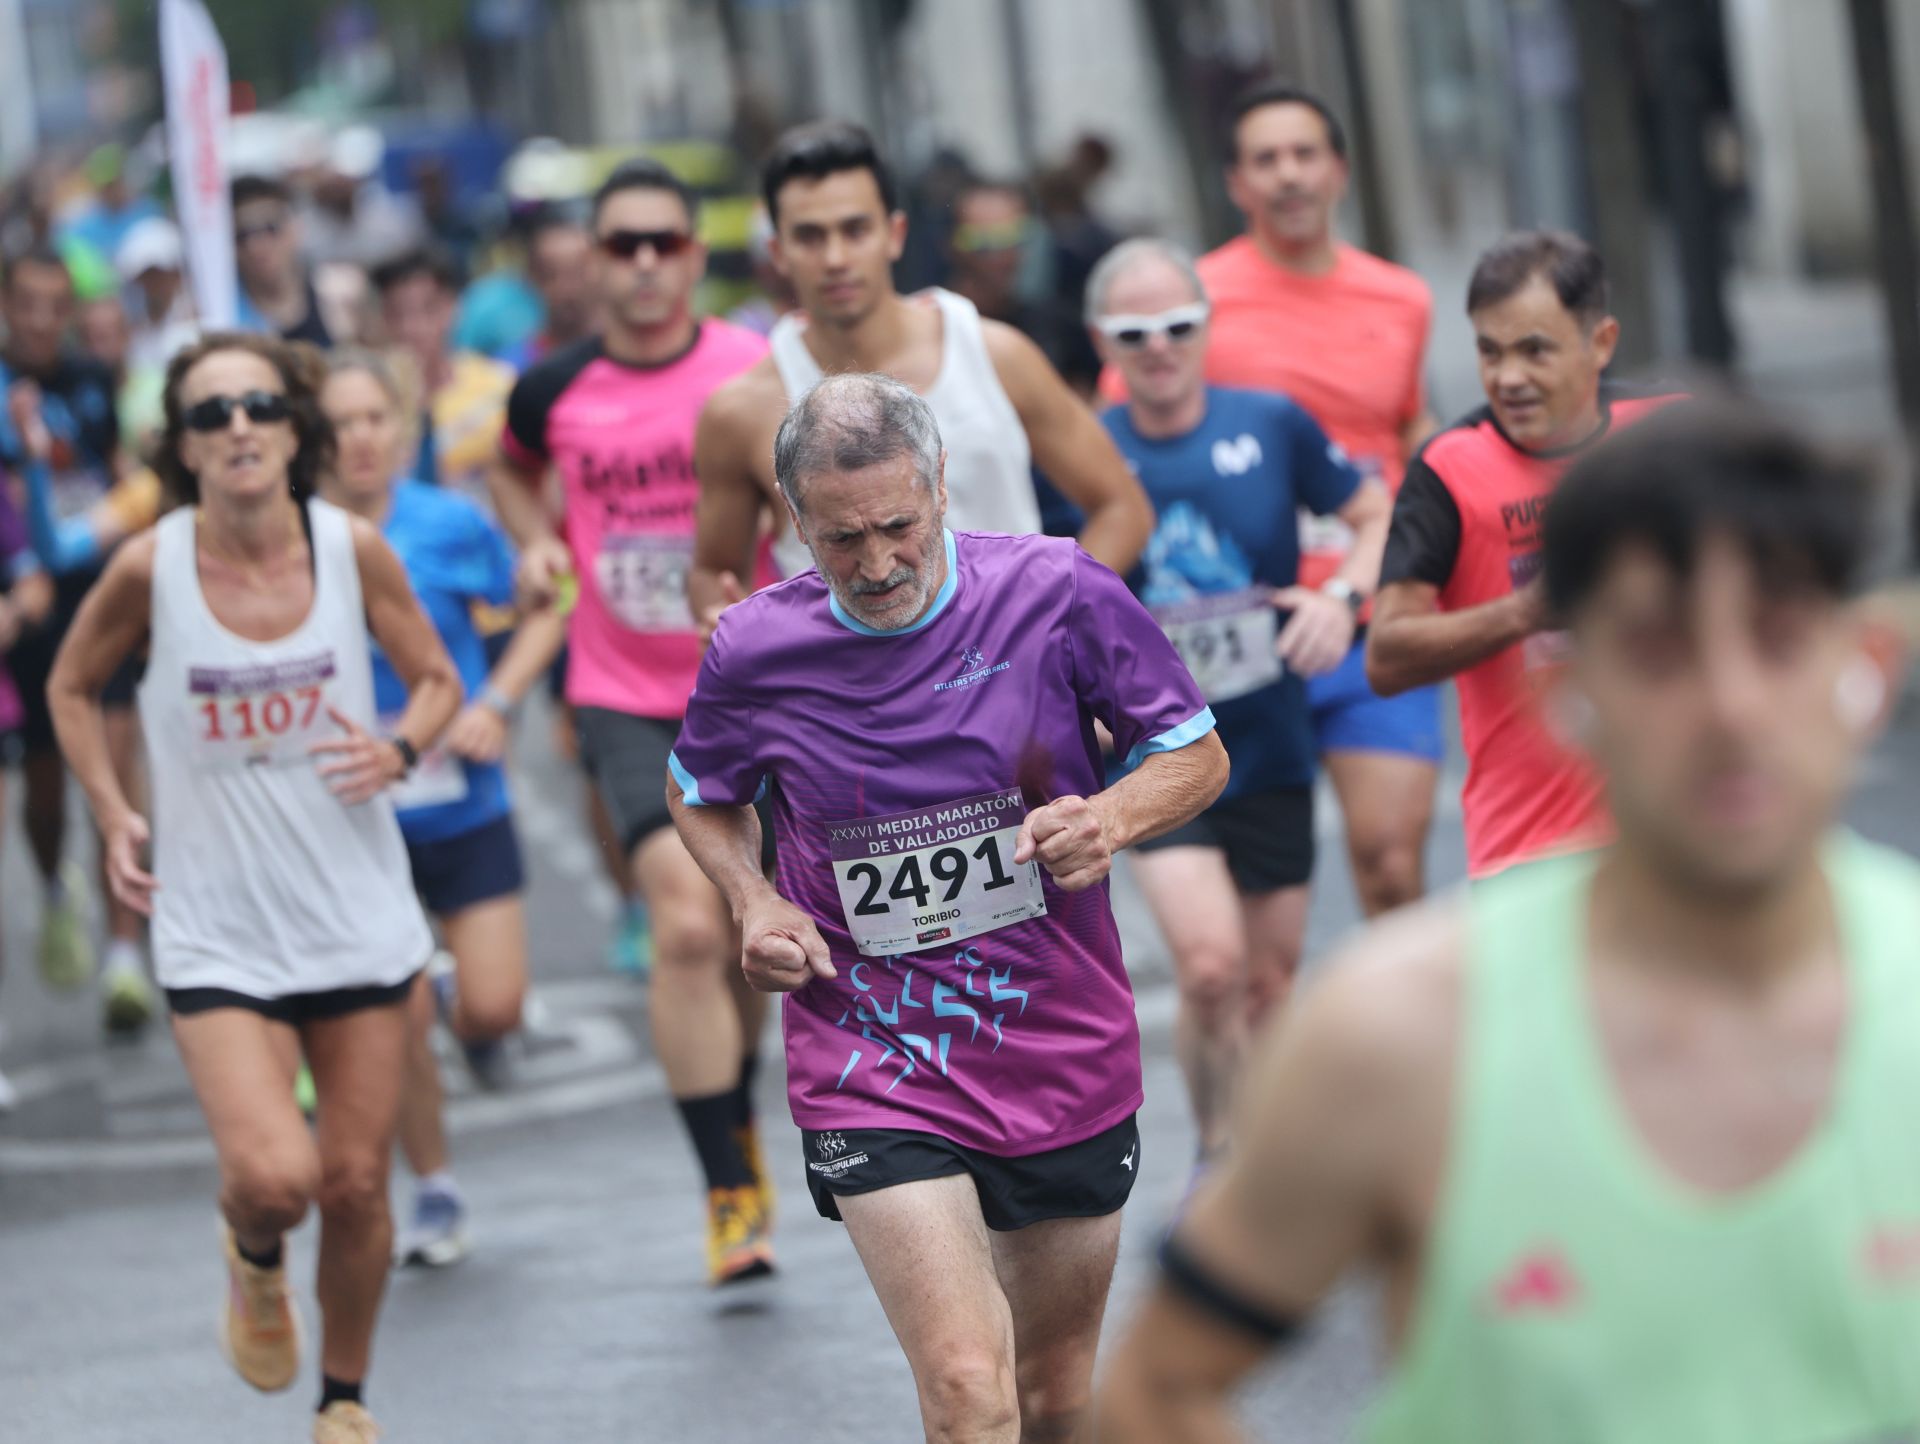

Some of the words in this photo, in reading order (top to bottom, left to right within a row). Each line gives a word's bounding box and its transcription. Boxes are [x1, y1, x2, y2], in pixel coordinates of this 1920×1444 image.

[934, 677, 968, 692] ATLETAS
[969, 661, 1010, 683] POPULARES
[200, 685, 321, 741] 1107
[830, 825, 872, 841] XXXVI
[877, 816, 933, 836] MEDIA
[936, 795, 1019, 823] MARATÓN
[868, 840, 891, 855] DE
[893, 816, 1000, 850] VALLADOLID
[846, 835, 1015, 916] 2491
[912, 908, 961, 927] TORIBIO
